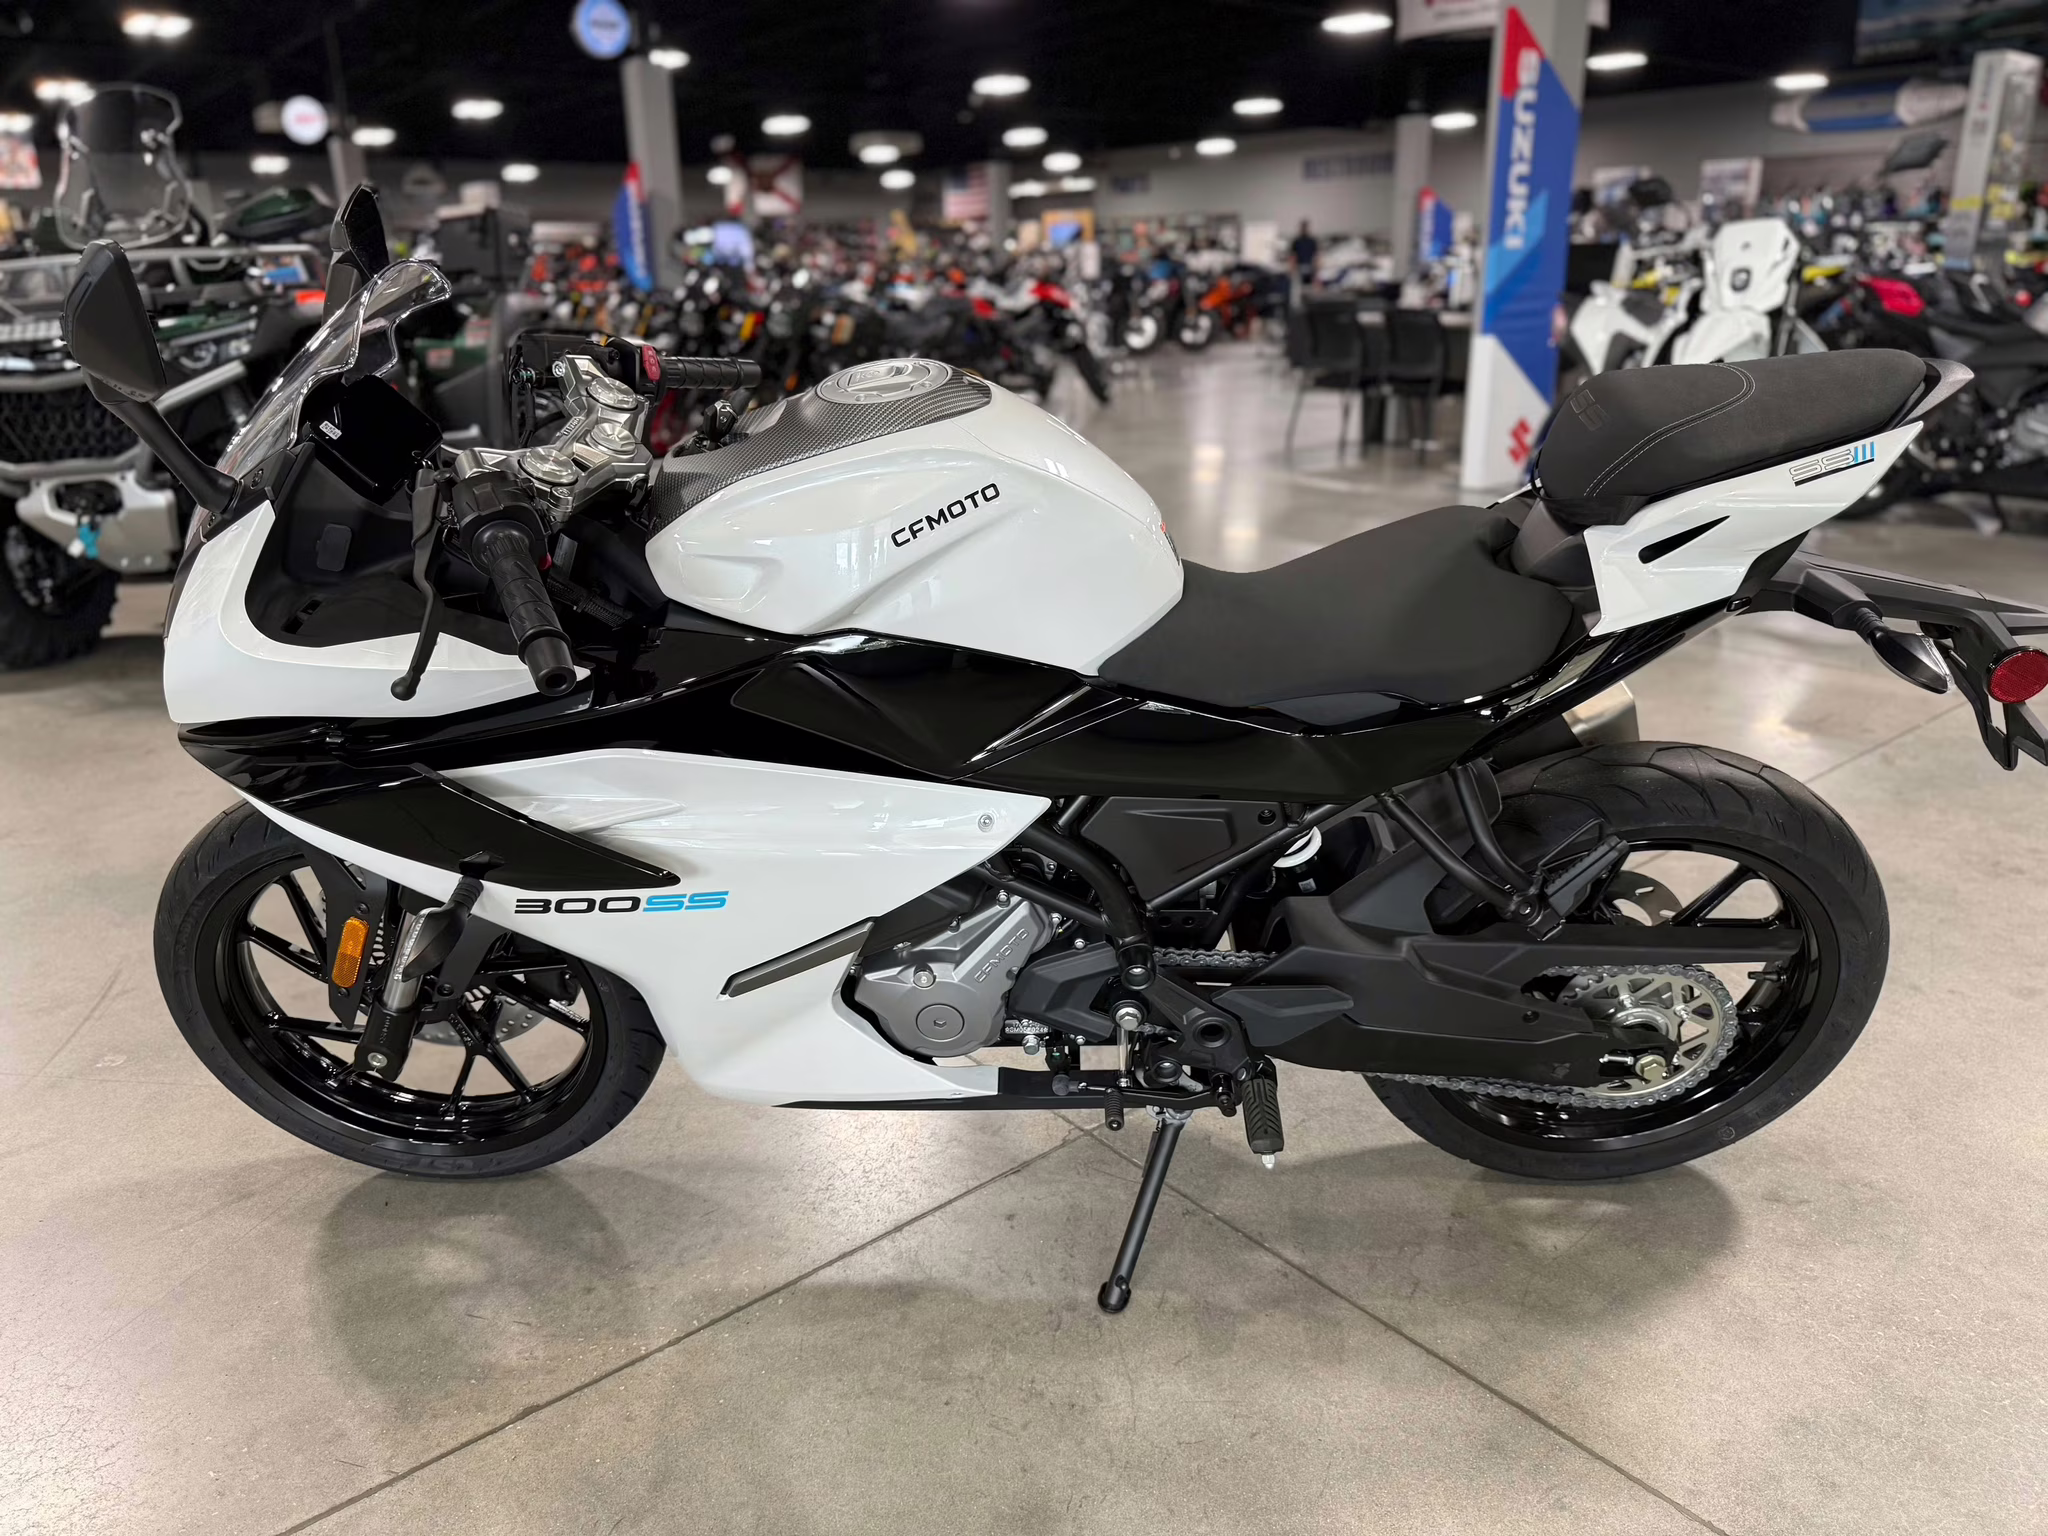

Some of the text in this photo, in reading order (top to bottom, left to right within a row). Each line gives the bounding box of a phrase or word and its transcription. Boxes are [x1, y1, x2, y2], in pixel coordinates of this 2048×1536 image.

[1504, 47, 1541, 249] SUZUKI
[891, 483, 1000, 547] CFMOTO
[514, 891, 729, 914] 300SS
[974, 928, 1029, 983] CFMOTO
